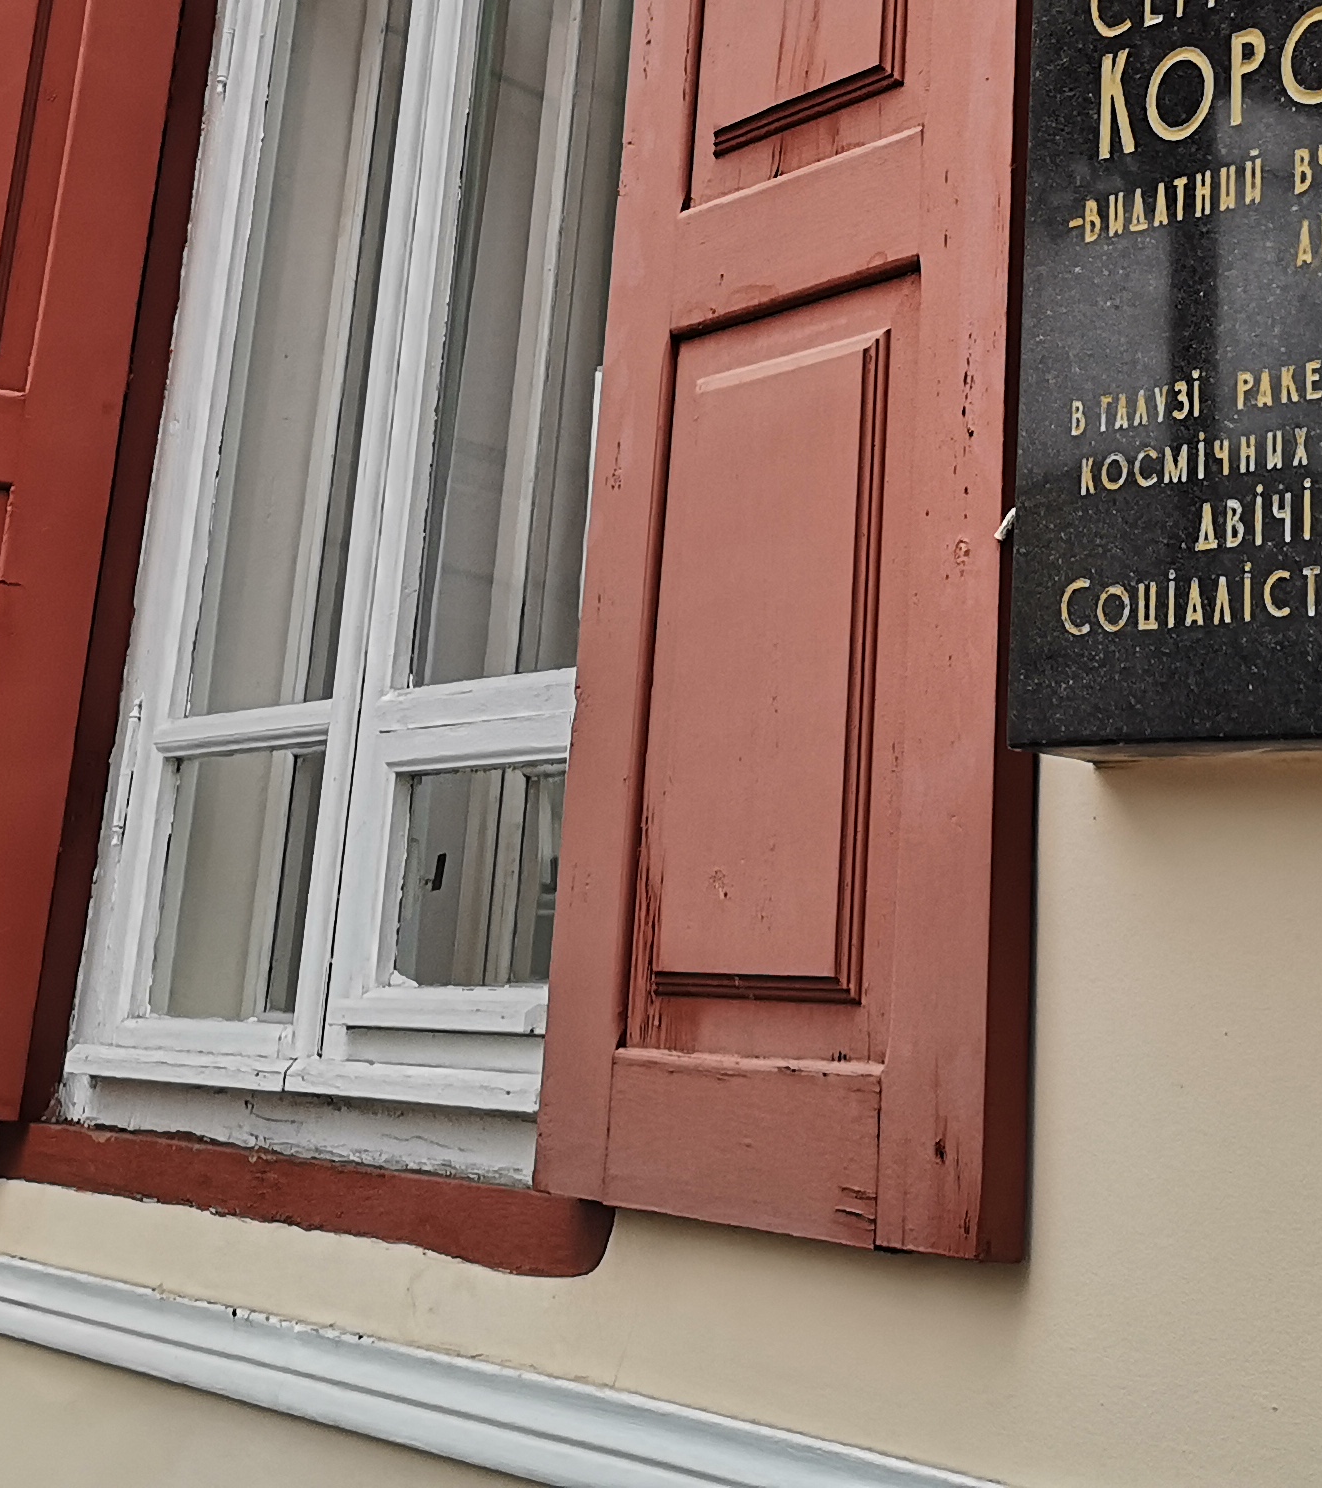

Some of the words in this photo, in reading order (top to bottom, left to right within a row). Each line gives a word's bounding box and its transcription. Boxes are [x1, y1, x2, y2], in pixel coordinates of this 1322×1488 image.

[1071, 398, 1086, 435] В
[1099, 369, 1202, 433] ГАЛУЗІ
[1080, 427, 1307, 495] КОСМІЧНИХ
[1195, 482, 1312, 551] ДВІЧІ
